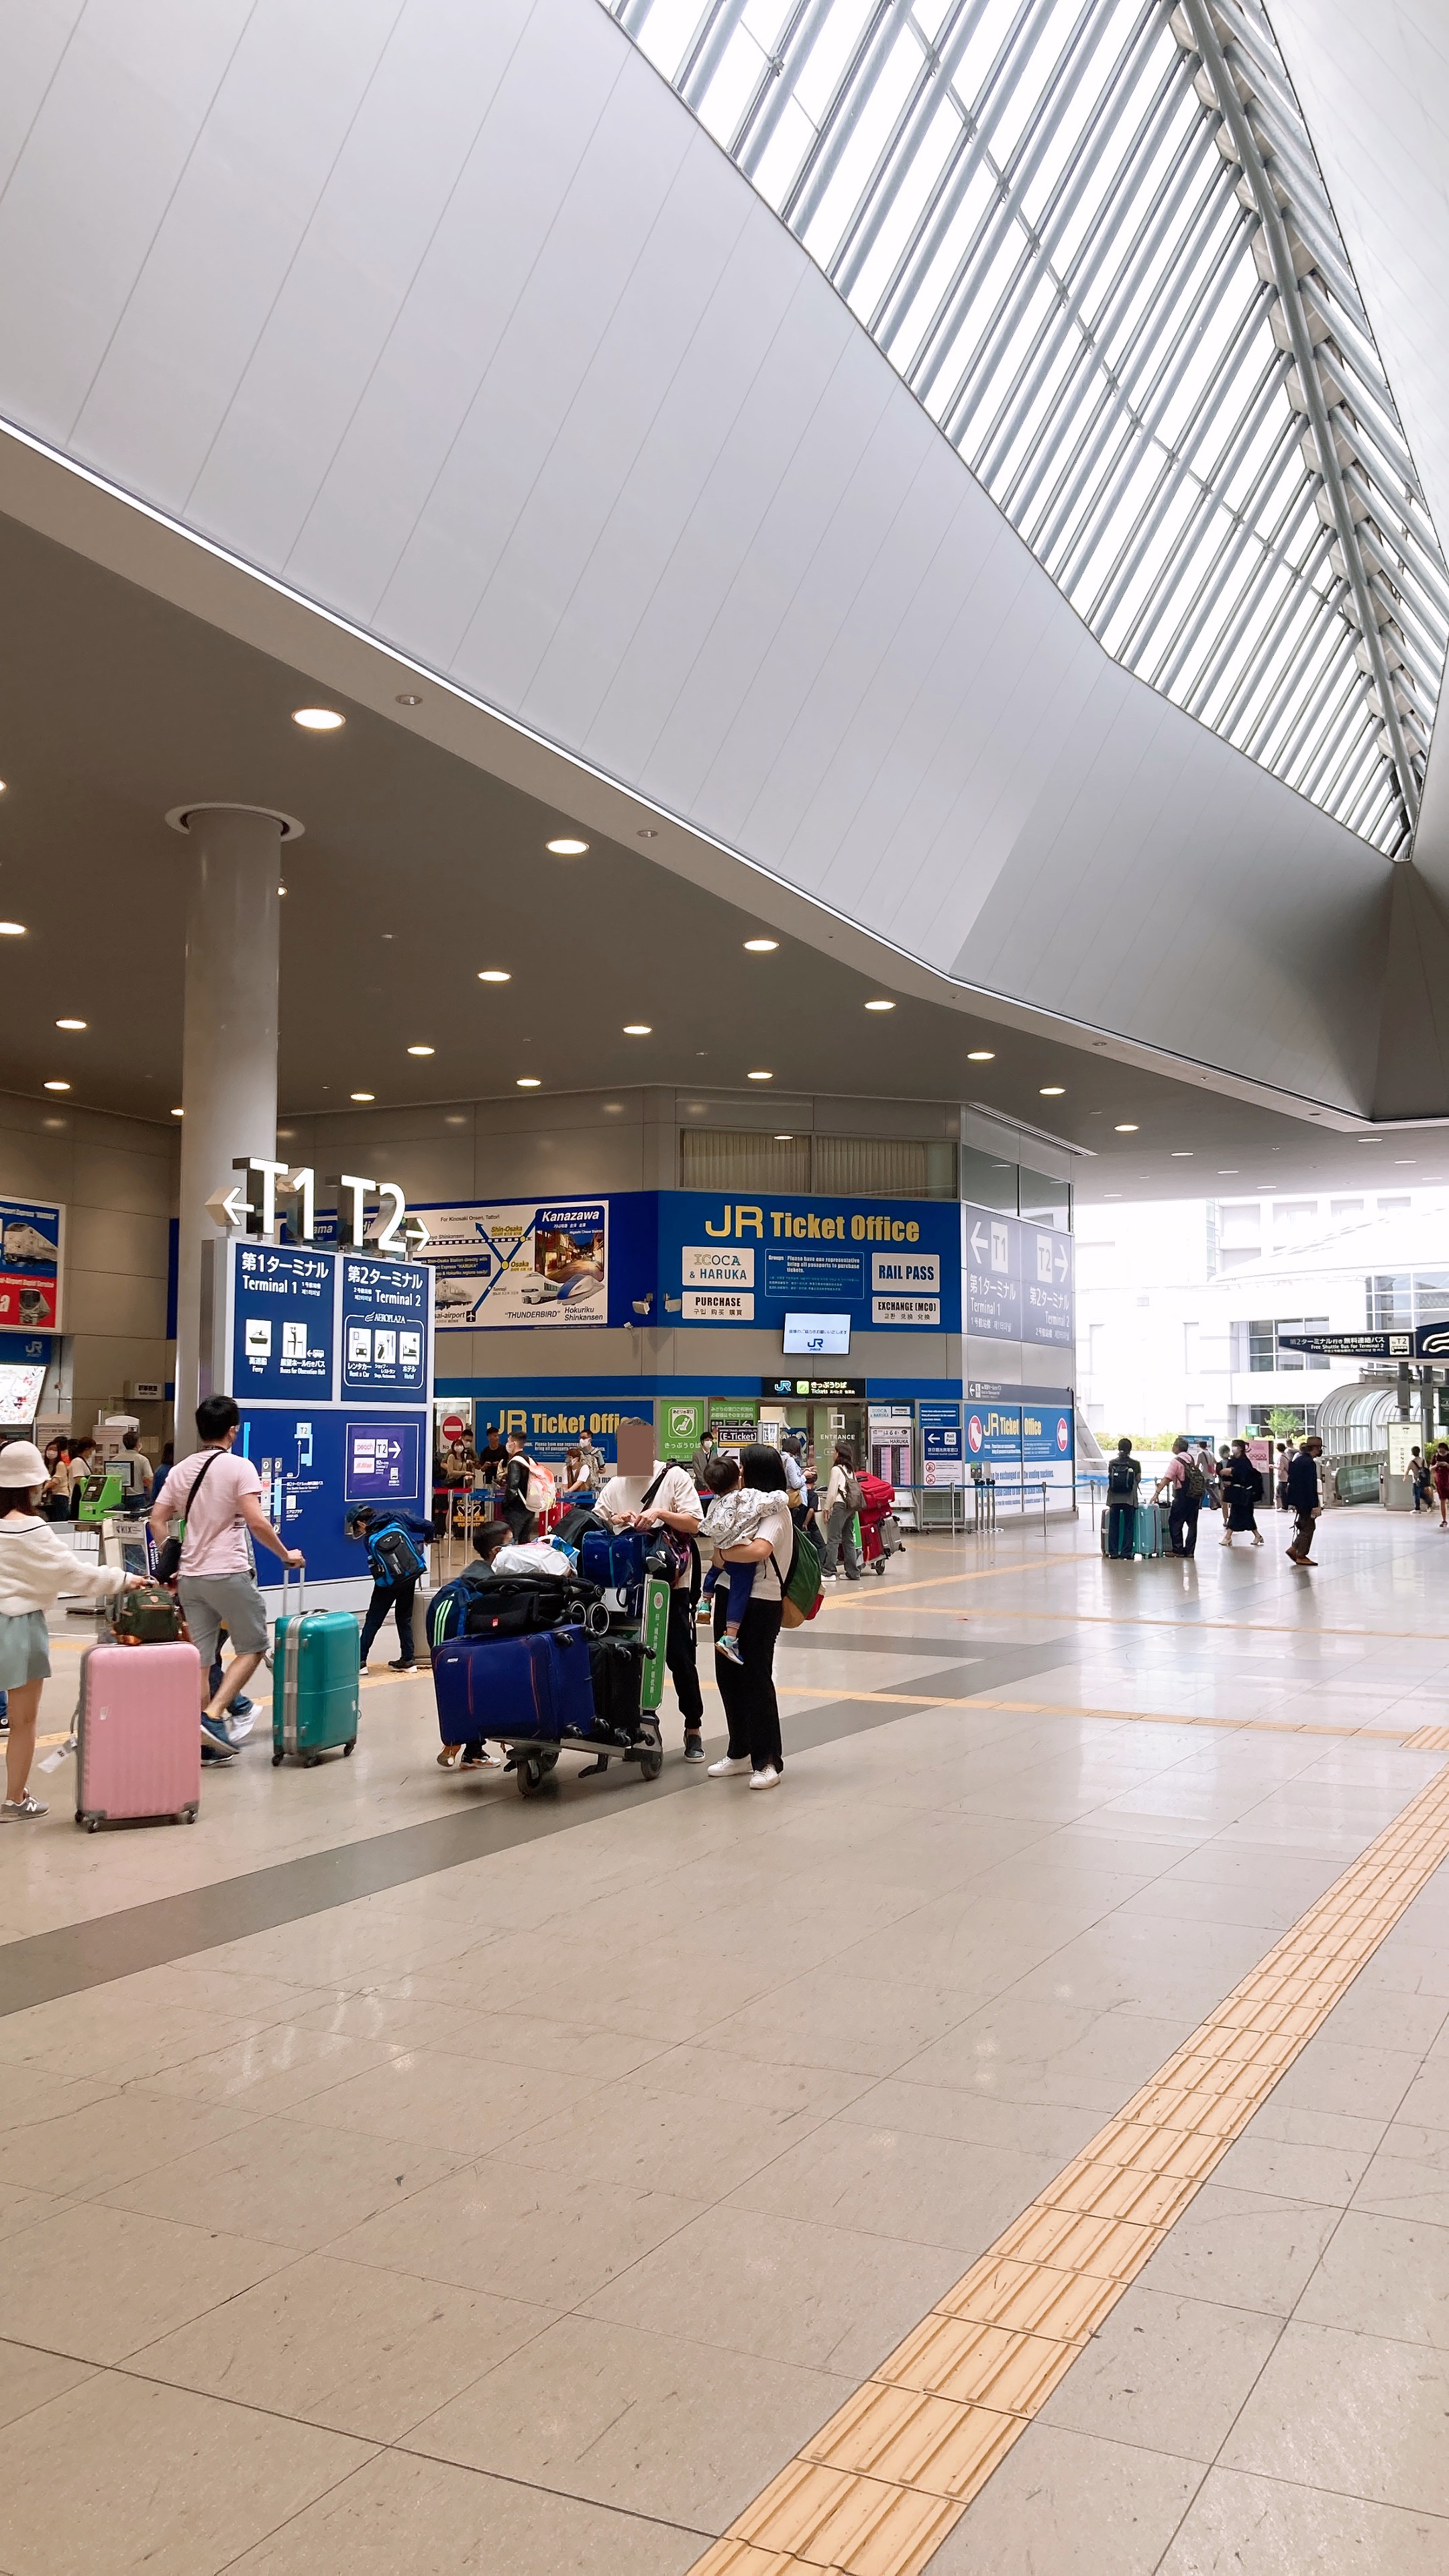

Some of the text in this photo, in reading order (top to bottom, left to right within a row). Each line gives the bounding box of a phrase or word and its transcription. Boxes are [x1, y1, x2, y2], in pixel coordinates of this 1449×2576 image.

[249, 1157, 315, 1240] T1
[340, 1174, 407, 1252] T2
[541, 1211, 599, 1222] Kanazawa
[705, 1205, 920, 1242] JR Ticket Office
[994, 1234, 1006, 1262] T1
[241, 1252, 329, 1279] 第1ターミナル
[694, 1253, 741, 1266] ICOCA
[1038, 1247, 1051, 1273] T2
[347, 1265, 423, 1289] 第2ターミナル
[689, 1268, 747, 1280] & HARUKA
[879, 1265, 934, 1281] RAIL PASS
[242, 1275, 297, 1294] Terminal 1
[969, 1273, 1016, 1301] 第1ターミナル
[375, 1289, 421, 1307] Terminal 2
[695, 1297, 741, 1307] PURCHASE
[877, 1301, 914, 1311] EXCHANGE
[970, 1297, 1000, 1316] Terminal 1
[1030, 1286, 1069, 1310] 第2ターミナル
[374, 1313, 406, 1324] AEROPLAZA
[1045, 1311, 1070, 1328] Terminal 2
[807, 1338, 824, 1348] JR
[347, 1362, 372, 1371] レンタカー
[402, 1365, 417, 1373] ホテル
[532, 1413, 585, 1434] Ticket
[983, 1413, 1042, 1437] JR Ticket Office
[357, 1443, 386, 1454] peach T2
[121, 1525, 132, 1534] KIX
